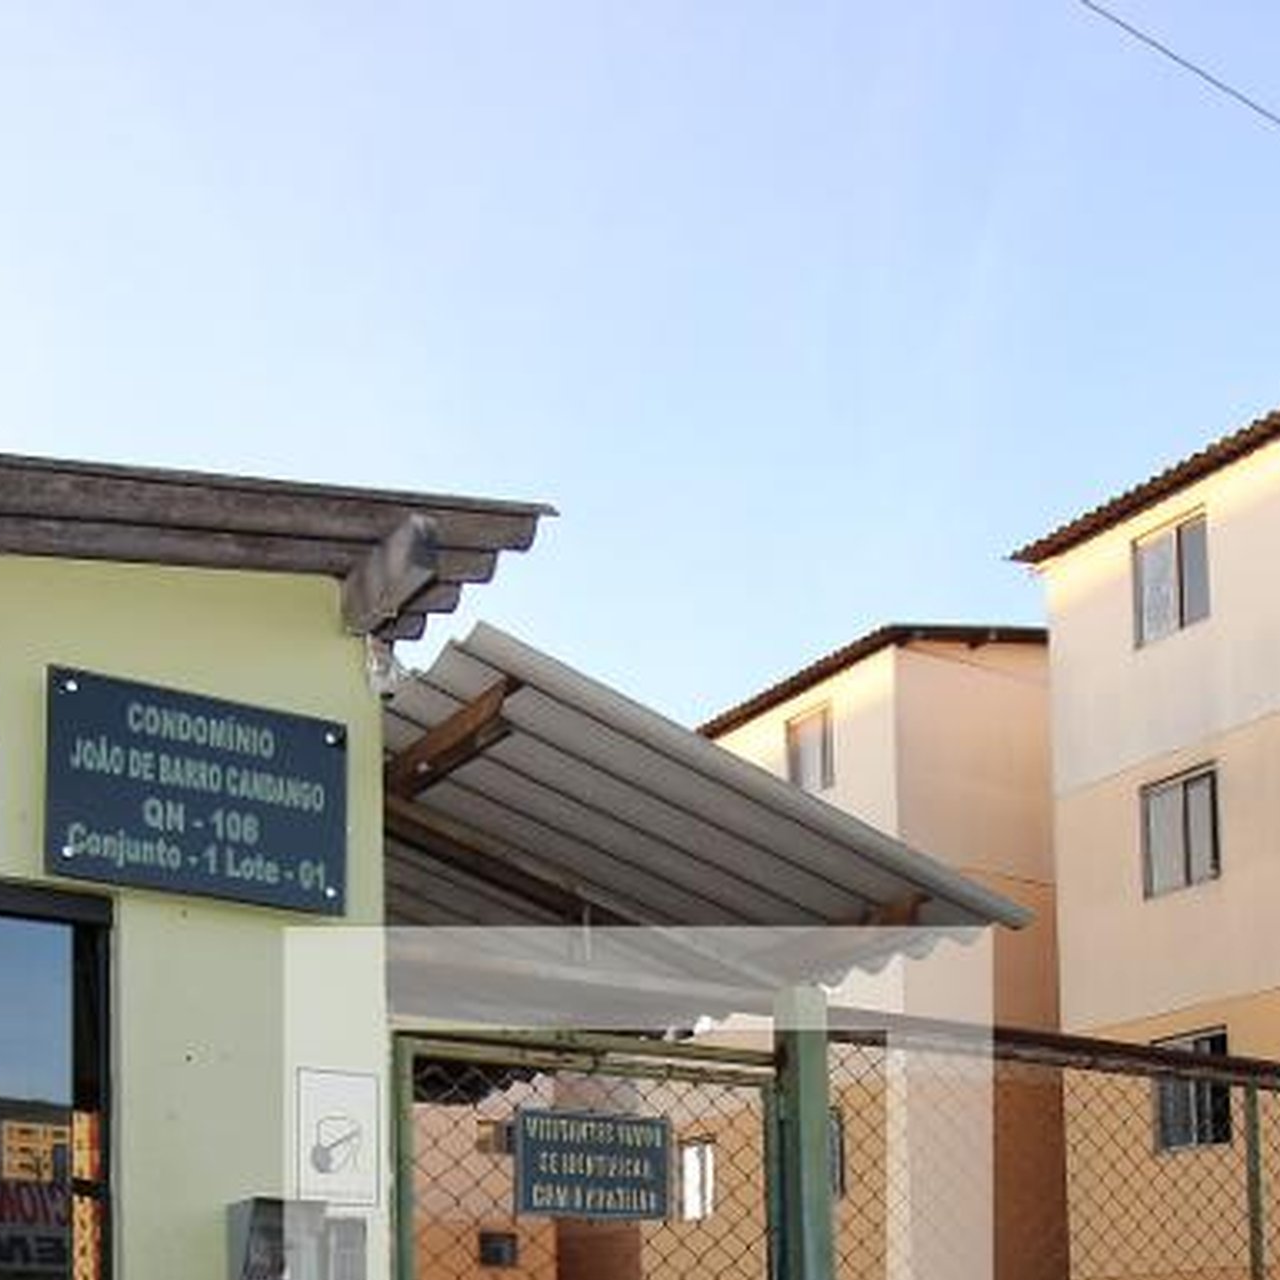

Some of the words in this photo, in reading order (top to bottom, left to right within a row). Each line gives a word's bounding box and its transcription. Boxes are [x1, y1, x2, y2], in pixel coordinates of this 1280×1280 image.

[128, 703, 274, 759] CONDOMÍNIO
[71, 736, 122, 775] JOÃO
[129, 747, 155, 781] DE
[159, 754, 220, 793] BARRO
[226, 766, 325, 811] CANDANGO
[67, 823, 182, 869] Conjunto
[202, 843, 217, 876] 1
[227, 846, 279, 884] Lote
[299, 858, 326, 892] 01
